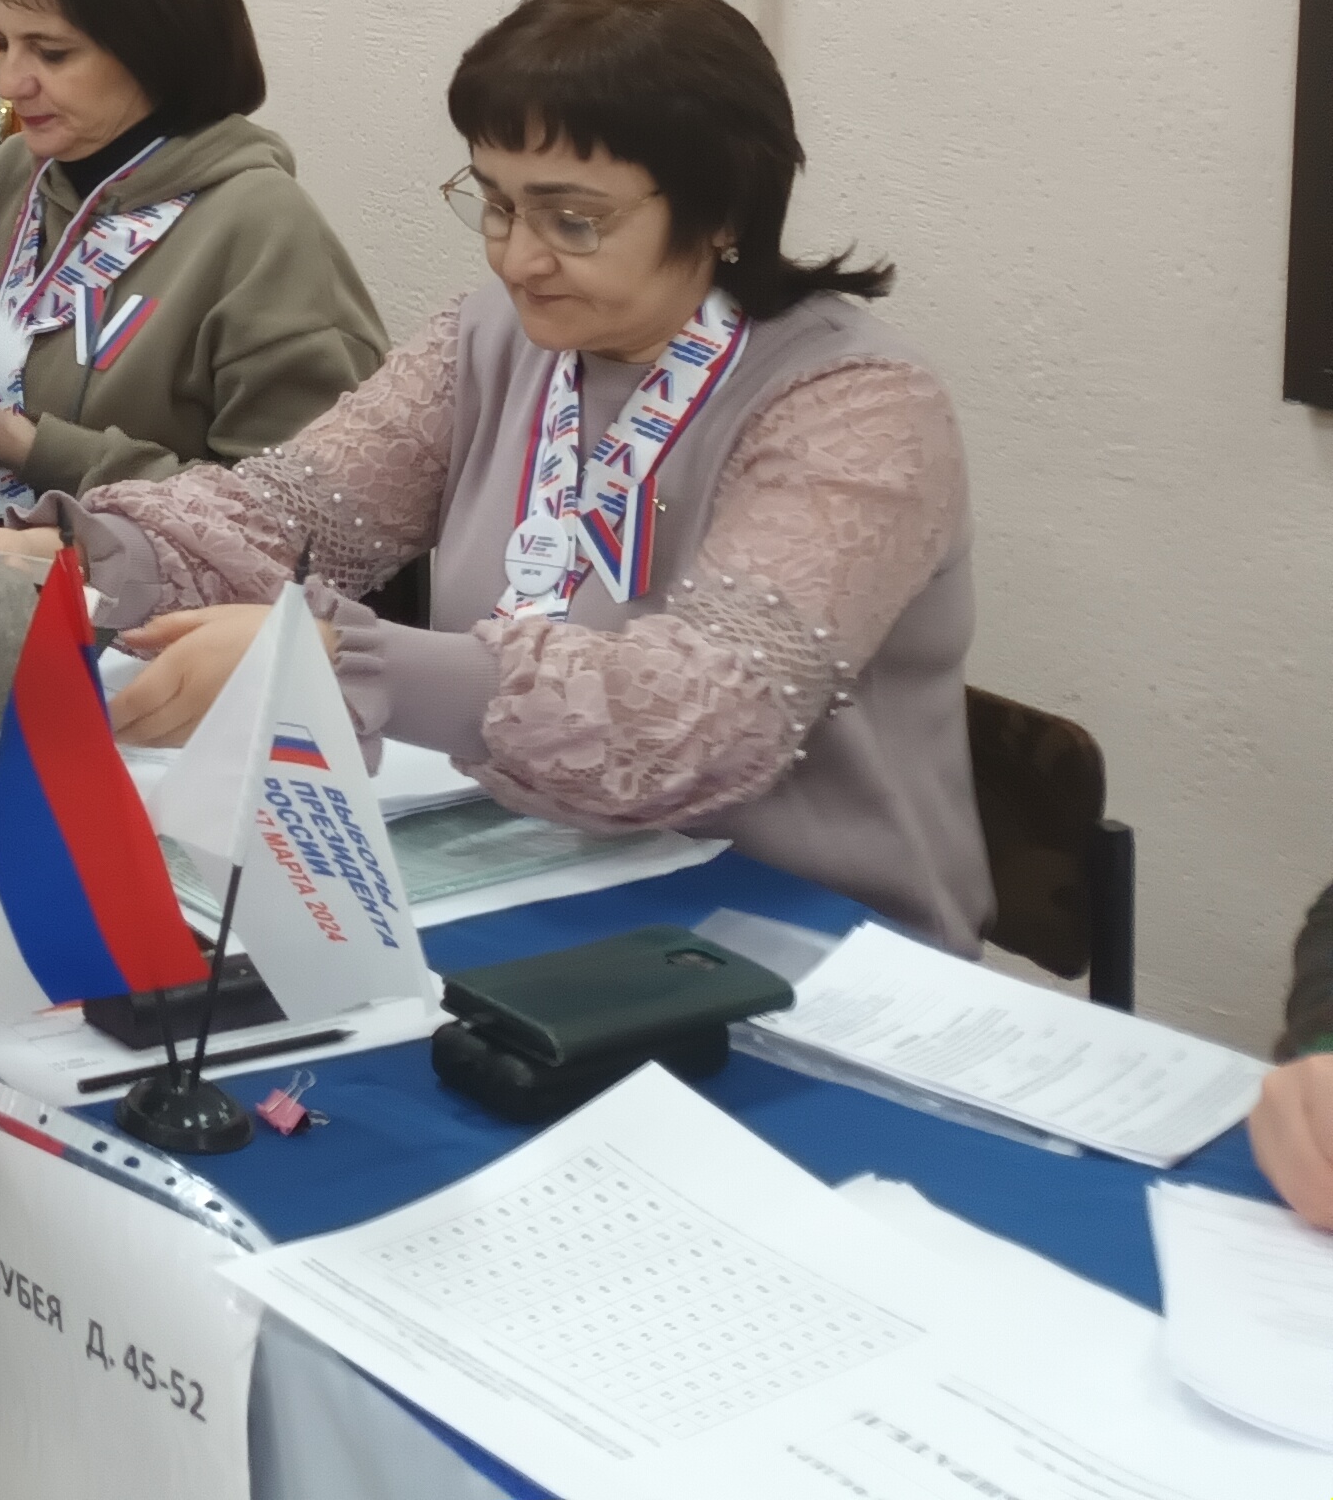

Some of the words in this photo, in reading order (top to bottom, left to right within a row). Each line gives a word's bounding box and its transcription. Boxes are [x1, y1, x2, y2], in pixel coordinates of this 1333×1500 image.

[261, 831, 318, 895] МАРТА
[304, 901, 348, 942] 2024
[288, 779, 400, 949] ПРЕЗИДЕНТА
[321, 785, 399, 912] ВЫБОРЫ
[86, 1318, 115, 1370] Д.
[123, 1344, 207, 1423] 45-52
